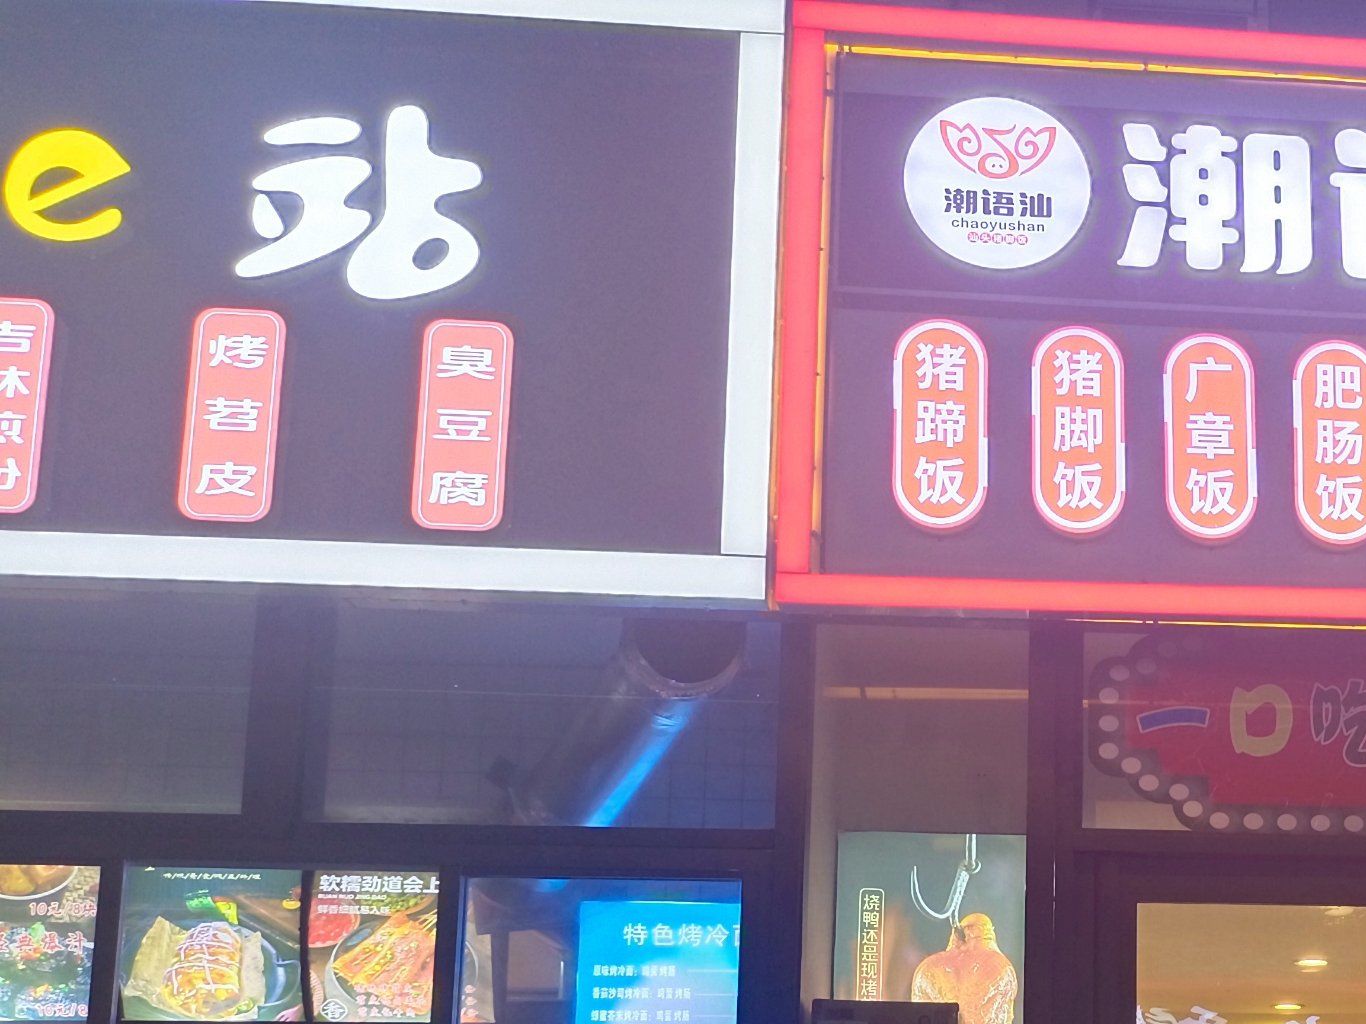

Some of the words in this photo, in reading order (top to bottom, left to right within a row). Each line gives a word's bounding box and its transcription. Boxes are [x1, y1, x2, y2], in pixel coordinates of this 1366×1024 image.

[944, 188, 1053, 218] 潮语汕
[951, 218, 1045, 233] chaoyushan
[195, 333, 269, 499] 烤苕皮
[429, 345, 496, 507] 臭豆腐
[914, 342, 967, 506] 猪蹄饭
[1052, 349, 1104, 511] 猪脚饭
[1184, 357, 1236, 517] 广章饭
[1313, 364, 1365, 522] 肥肠饭
[861, 893, 881, 1001] 烧鸭还是现烤
